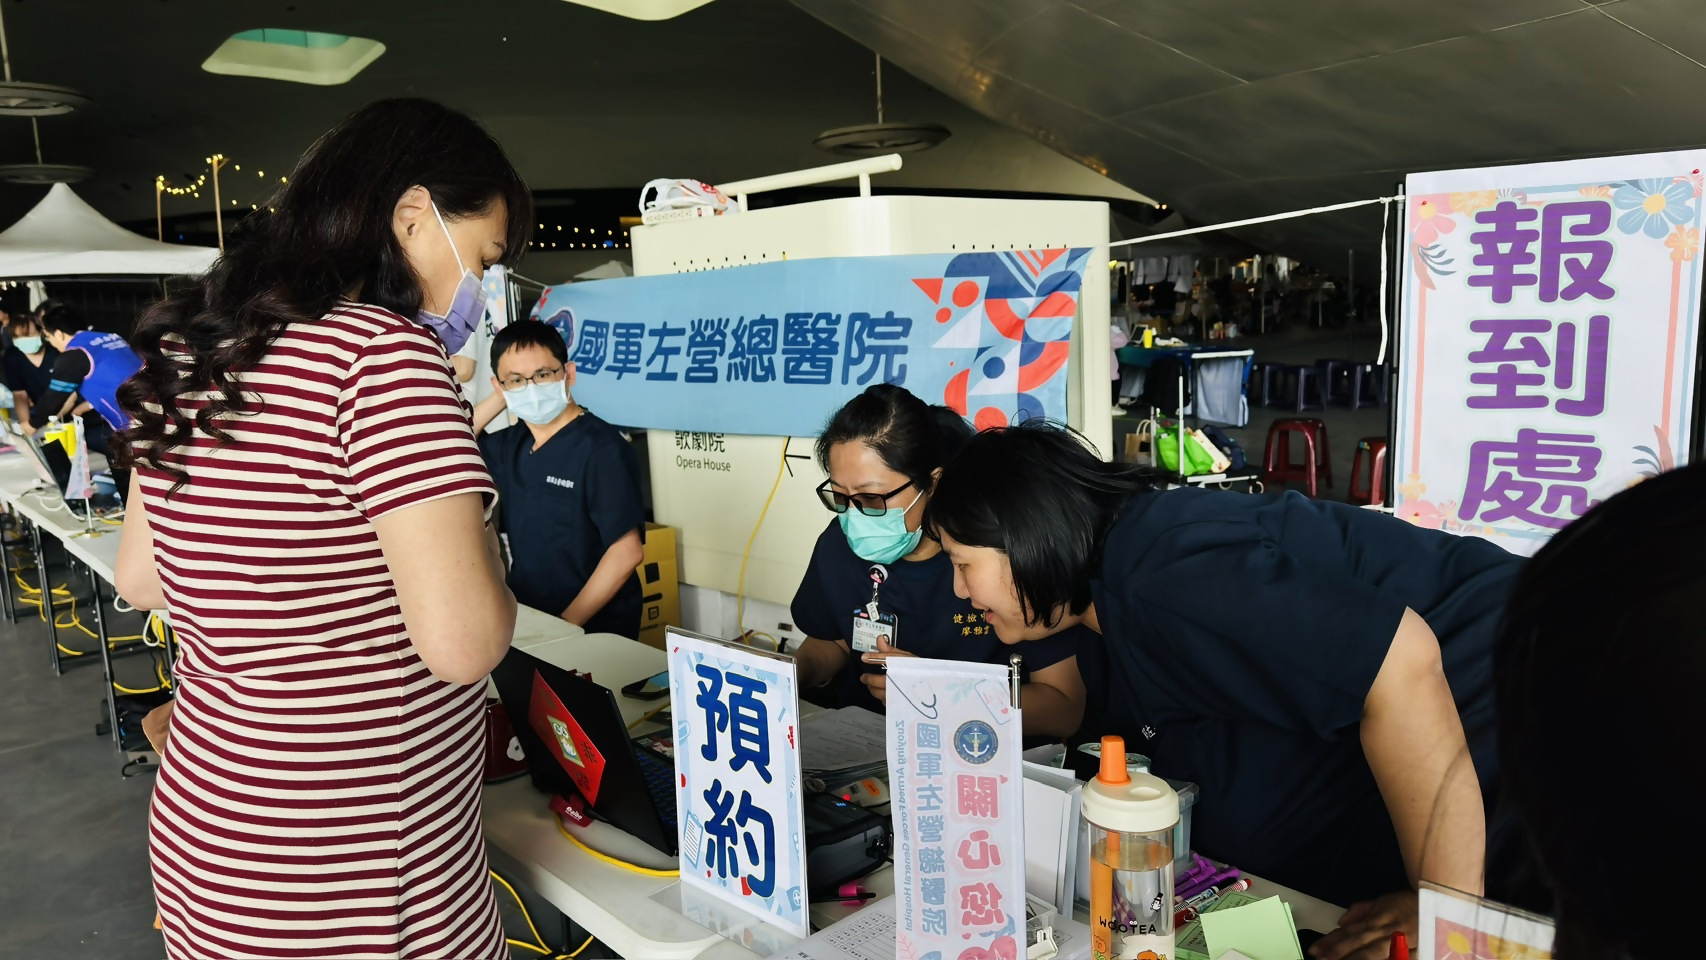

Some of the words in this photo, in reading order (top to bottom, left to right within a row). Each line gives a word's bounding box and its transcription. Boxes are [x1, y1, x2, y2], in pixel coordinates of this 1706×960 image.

[573, 310, 913, 386] 國軍左營總醫院
[1457, 200, 1616, 530] 報到處
[675, 430, 725, 452] 歌劇院
[676, 455, 701, 470] Opera
[703, 457, 731, 472] House
[695, 663, 776, 898] 預約
[1099, 916, 1157, 934] WOOTEA
